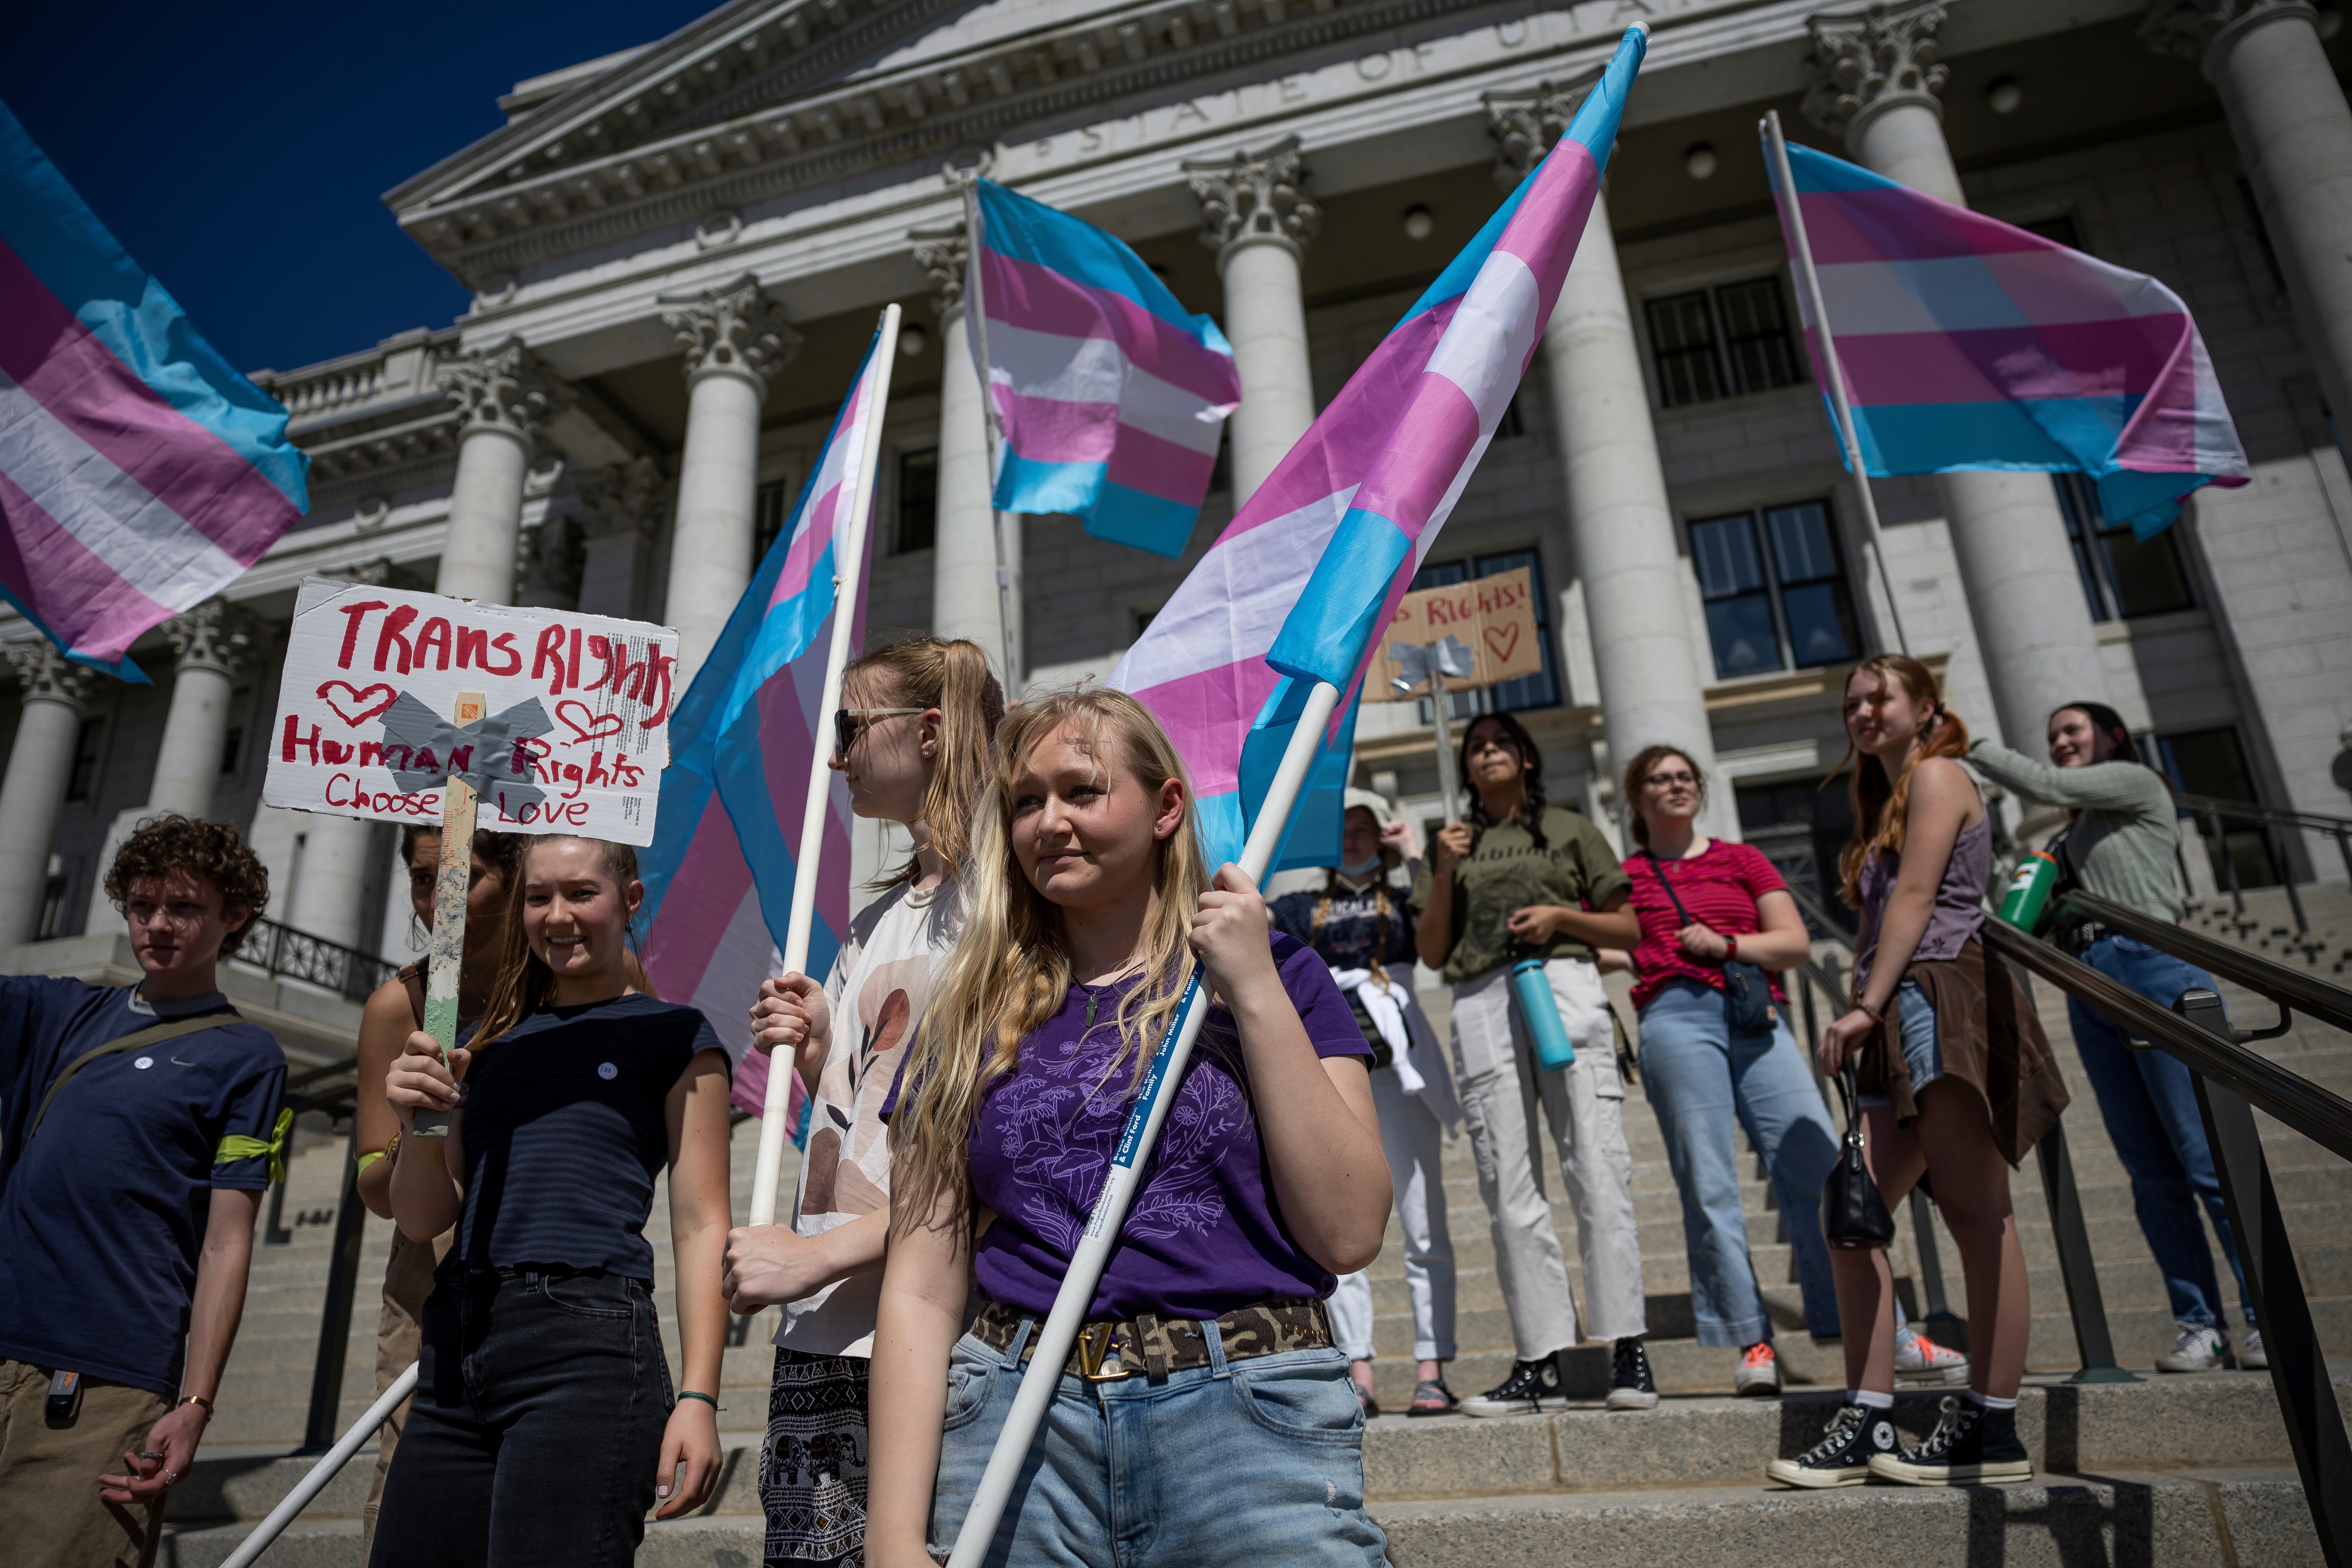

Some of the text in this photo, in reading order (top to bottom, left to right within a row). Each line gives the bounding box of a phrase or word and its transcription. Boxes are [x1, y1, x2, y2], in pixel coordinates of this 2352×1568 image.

[1354, 44, 1434, 80] OF
[325, 773, 589, 826] Choose Love
[1184, 970, 1198, 995] Family
[1160, 1038, 1171, 1056] John
[1168, 1013, 1180, 1036] Miller
[1142, 1074, 1157, 1100] Family
[1122, 1135, 1133, 1153] Clint
[1130, 1115, 1141, 1133] Ford
